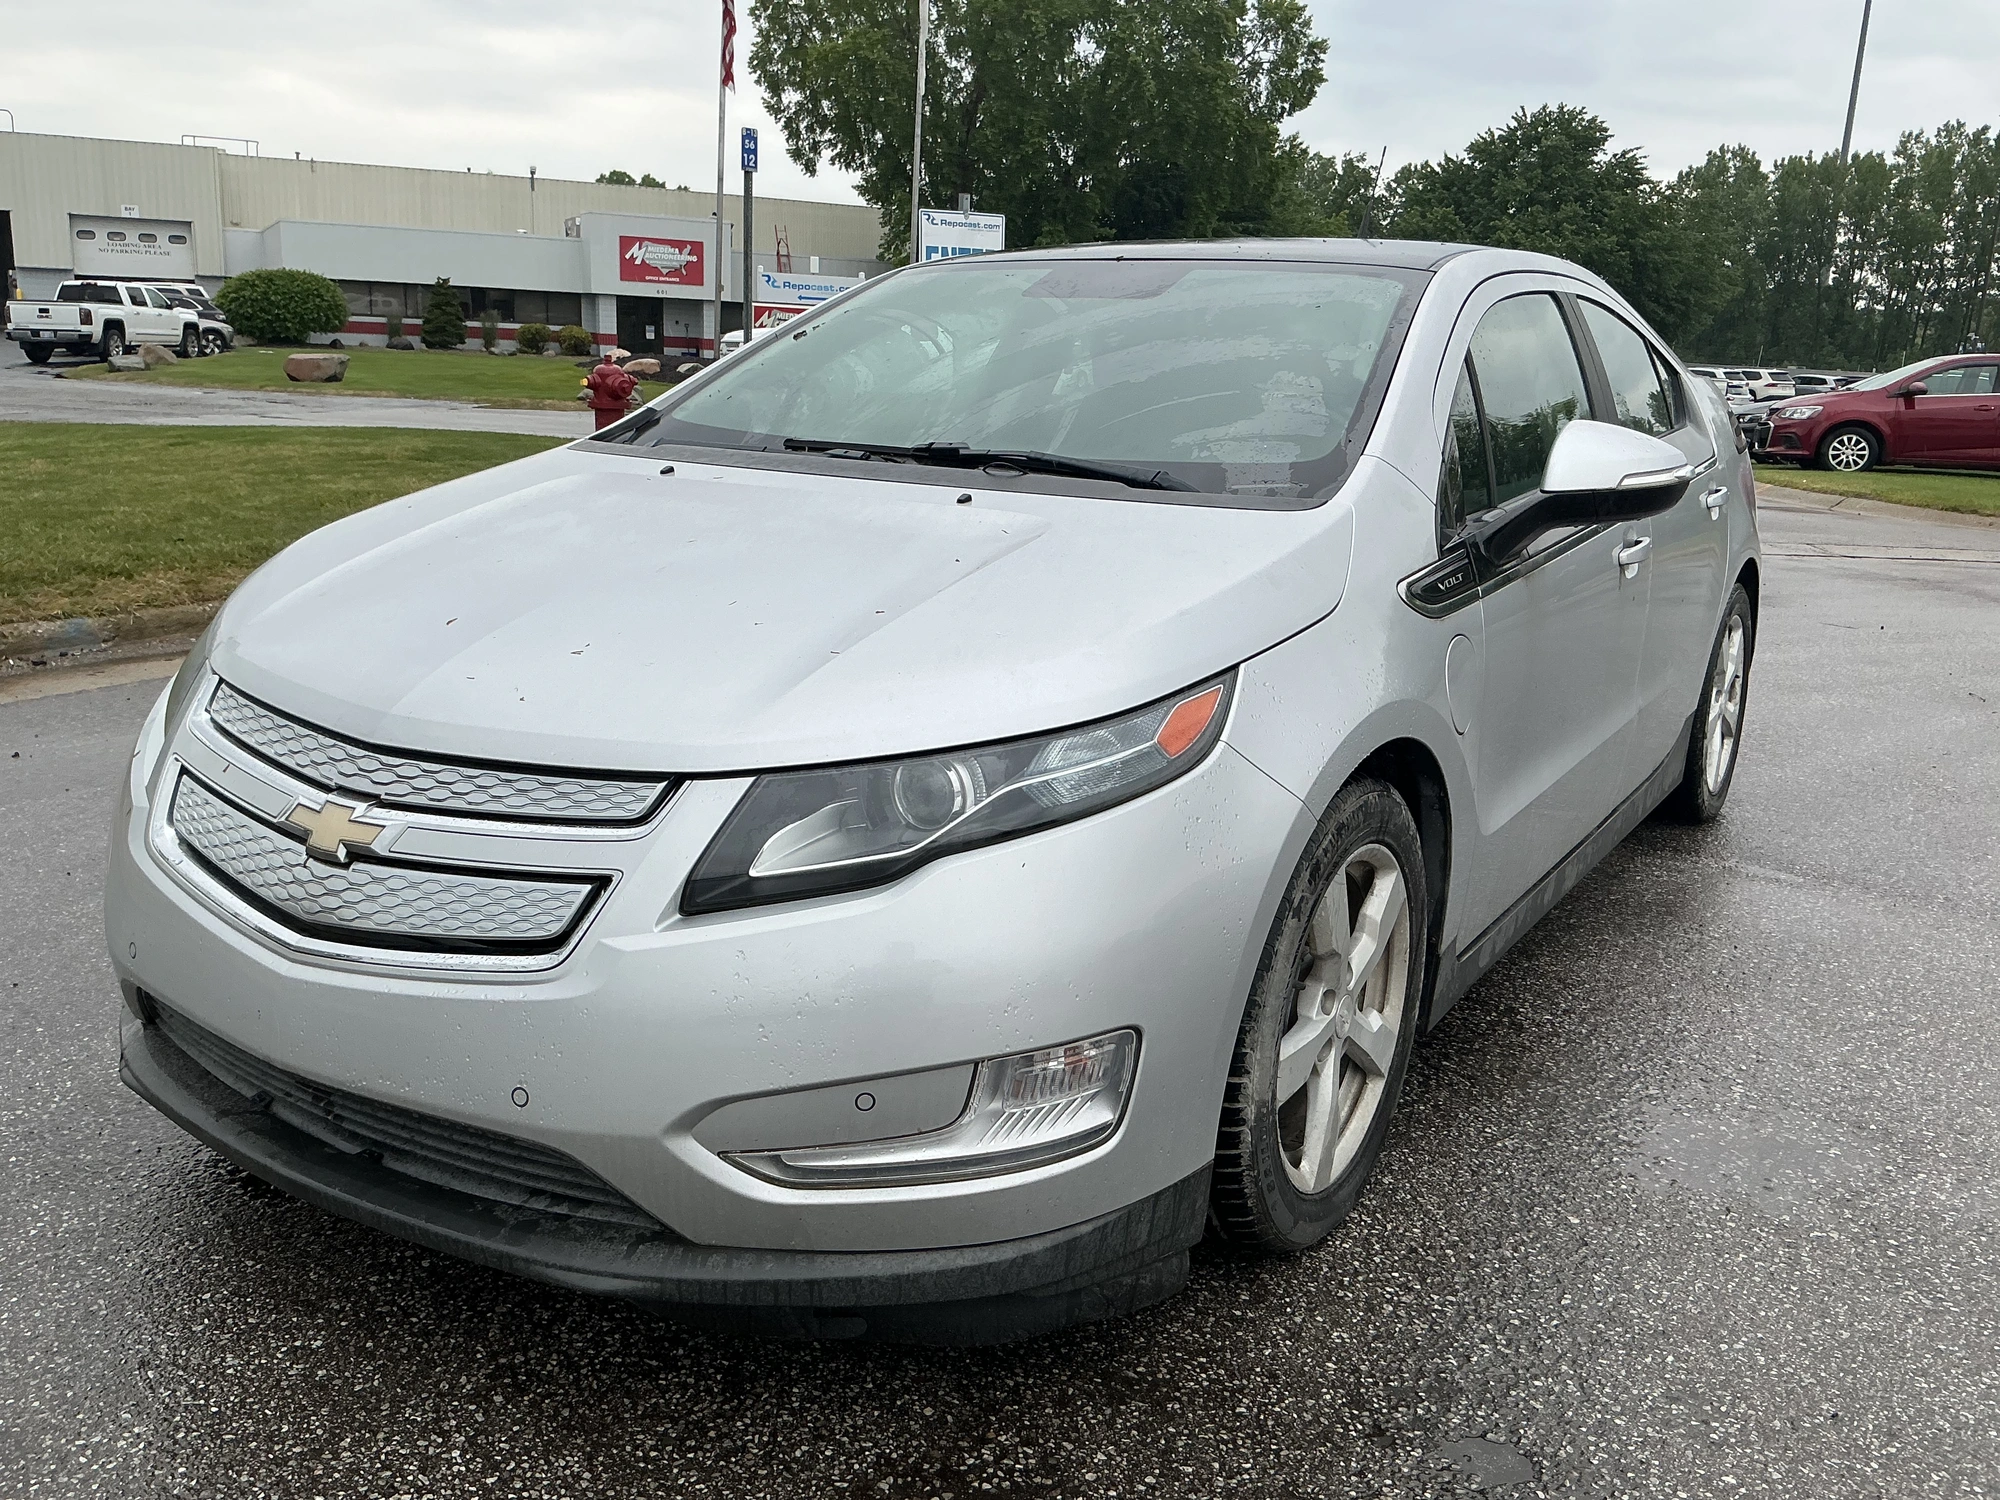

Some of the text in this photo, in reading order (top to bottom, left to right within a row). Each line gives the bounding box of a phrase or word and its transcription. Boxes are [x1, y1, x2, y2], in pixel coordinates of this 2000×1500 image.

[744, 139, 755, 149] 56
[743, 153, 755, 167] 12
[940, 219, 1000, 230] Repocast.com
[107, 241, 141, 249] LOADING
[647, 245, 680, 254] MIEDEMA
[645, 252, 698, 262] AUCTIONEERING
[783, 281, 850, 292] Repocast.c
[1437, 573, 1463, 591] VOLT
